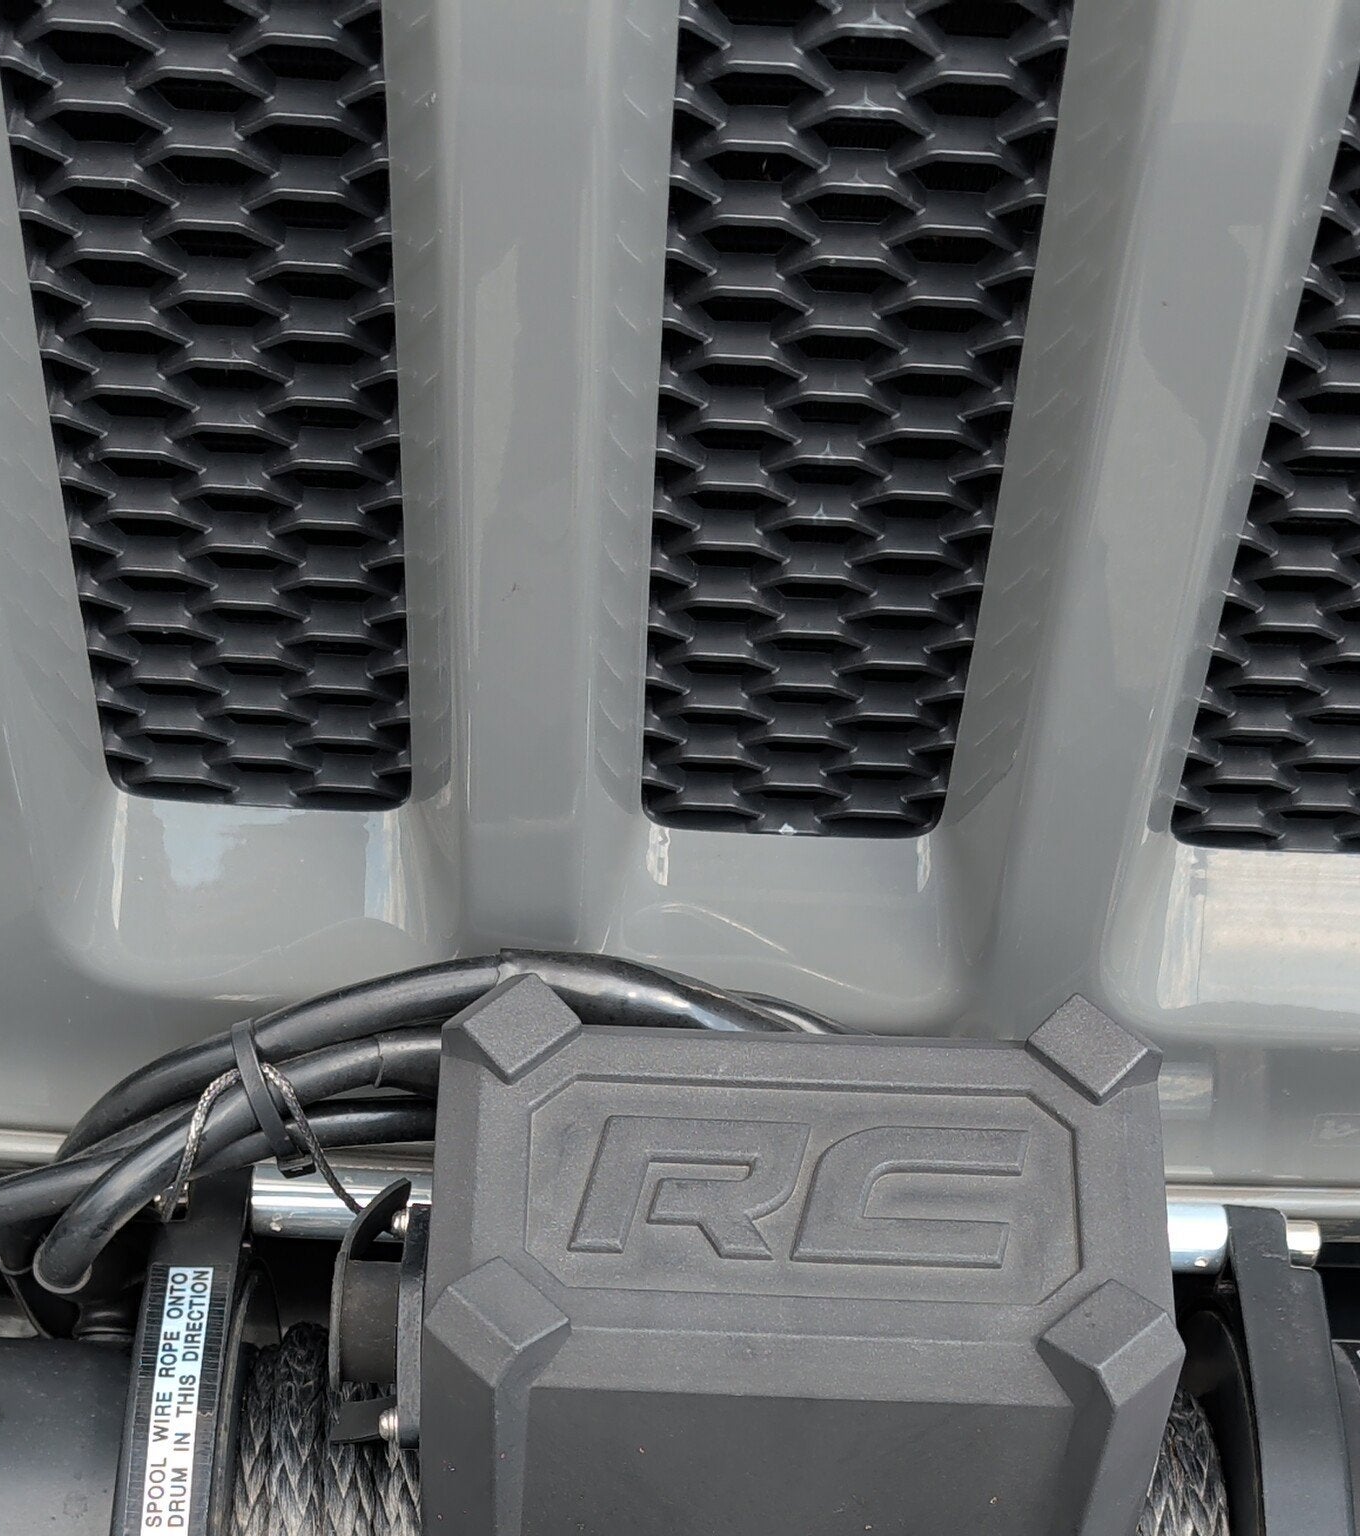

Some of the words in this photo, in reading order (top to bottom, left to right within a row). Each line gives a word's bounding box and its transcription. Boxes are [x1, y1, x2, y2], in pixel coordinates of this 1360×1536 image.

[567, 1114, 1031, 1270] RC
[167, 1272, 188, 1319] ONTO
[182, 1269, 210, 1363] DIRECTION
[158, 1330, 180, 1379] ROPE
[152, 1390, 173, 1443] WIRE
[175, 1374, 196, 1418] THIS
[174, 1431, 191, 1452] IN
[145, 1456, 167, 1528] SPOOL
[167, 1467, 188, 1528] DRUM
